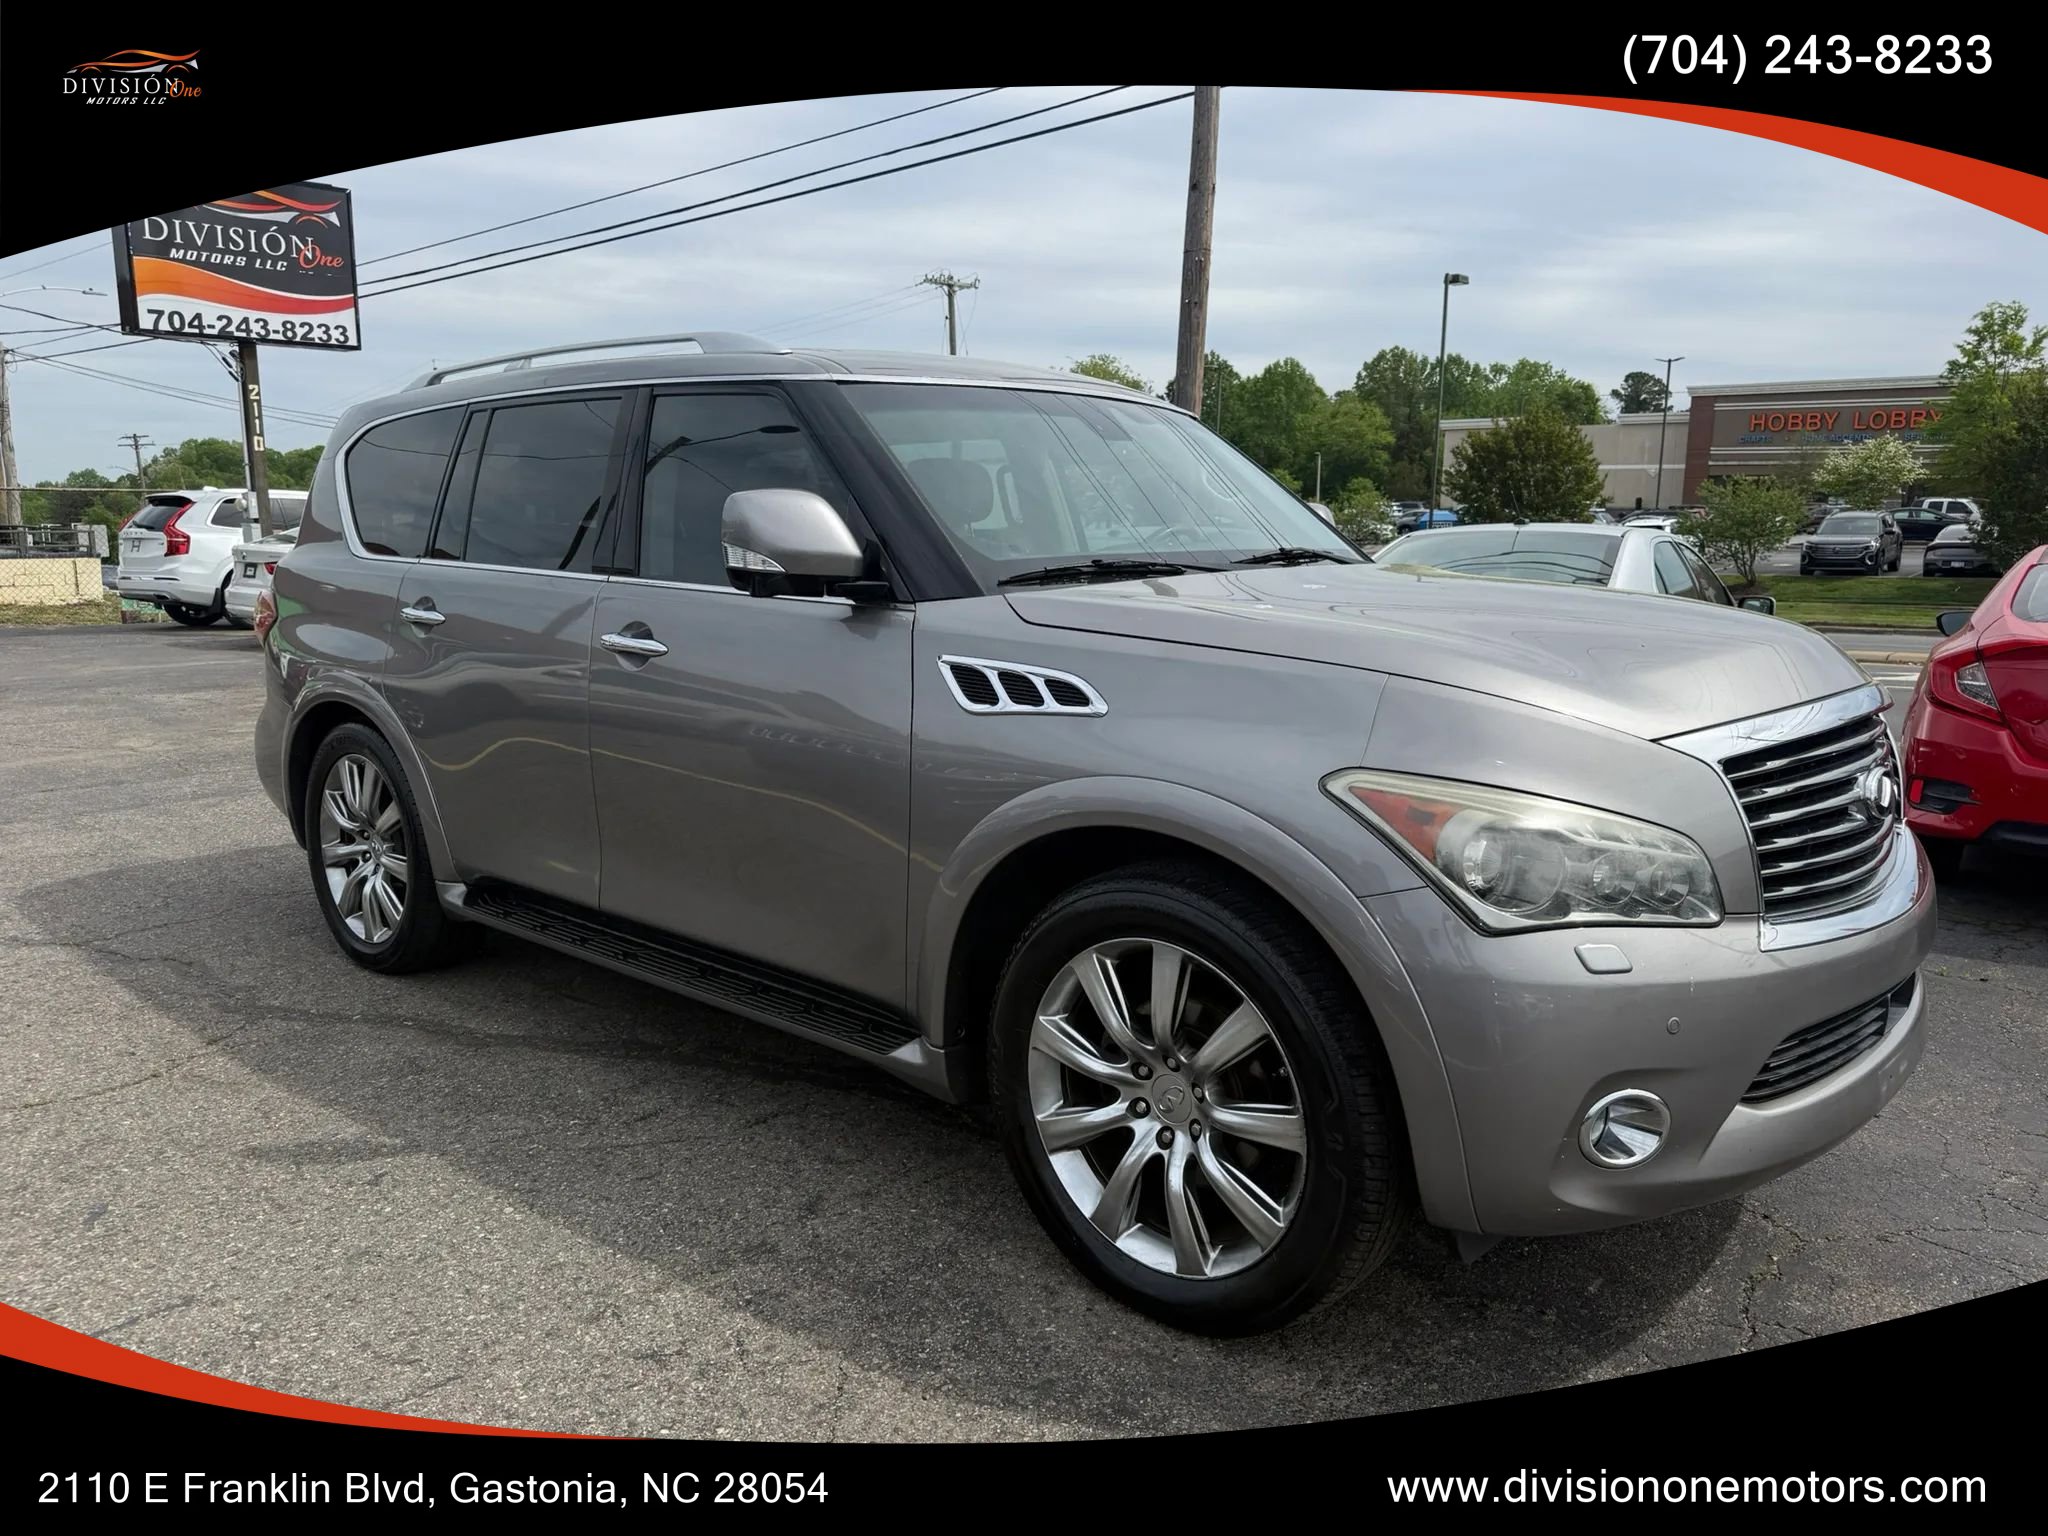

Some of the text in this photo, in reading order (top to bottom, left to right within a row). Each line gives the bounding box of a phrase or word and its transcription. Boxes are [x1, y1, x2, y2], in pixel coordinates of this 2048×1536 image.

[143, 216, 345, 269] DIVISIÓN One
[169, 247, 289, 271] MOTORS LLC
[147, 308, 350, 345] 704-243-8233
[1749, 411, 1840, 432] HOBBY
